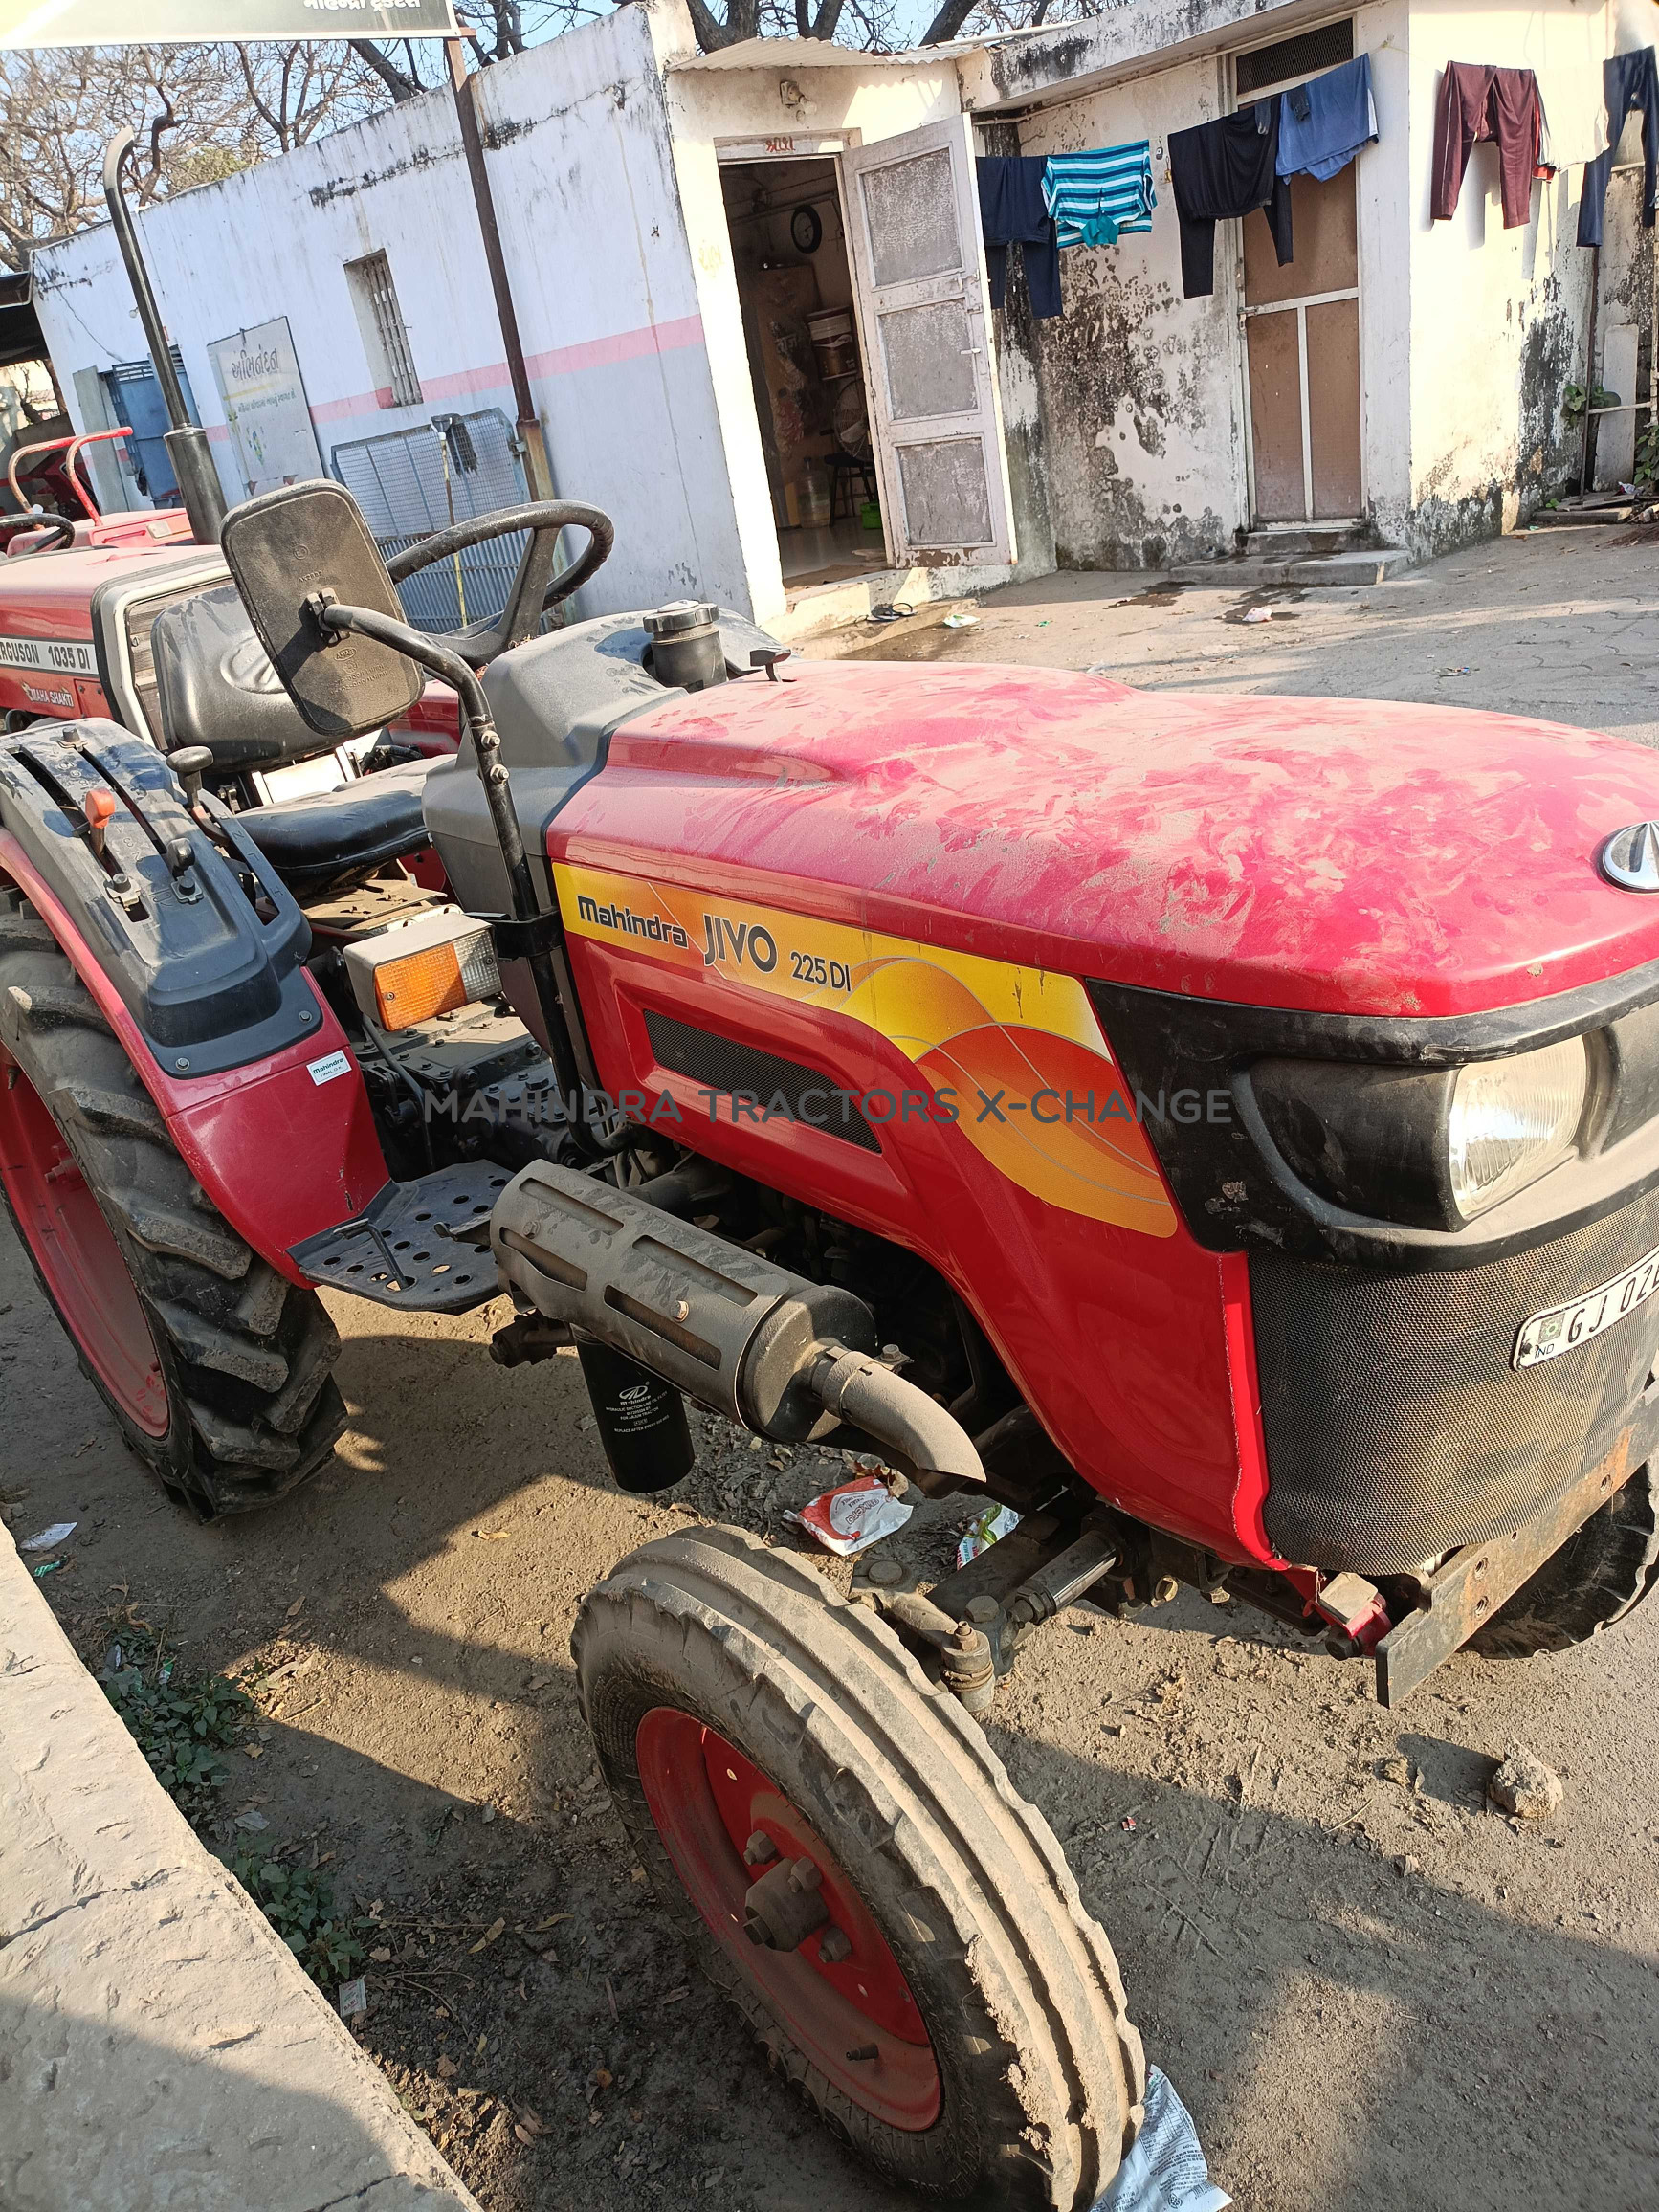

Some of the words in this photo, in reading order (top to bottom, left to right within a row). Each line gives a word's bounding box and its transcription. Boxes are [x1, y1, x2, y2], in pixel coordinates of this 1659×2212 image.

[0, 641, 39, 664] RGUSON
[48, 645, 76, 669] 1035
[77, 647, 91, 670] DI
[50, 691, 75, 707] SHAKTI
[702, 912, 779, 974] JIVO
[1567, 1294, 1608, 1344] GJ
